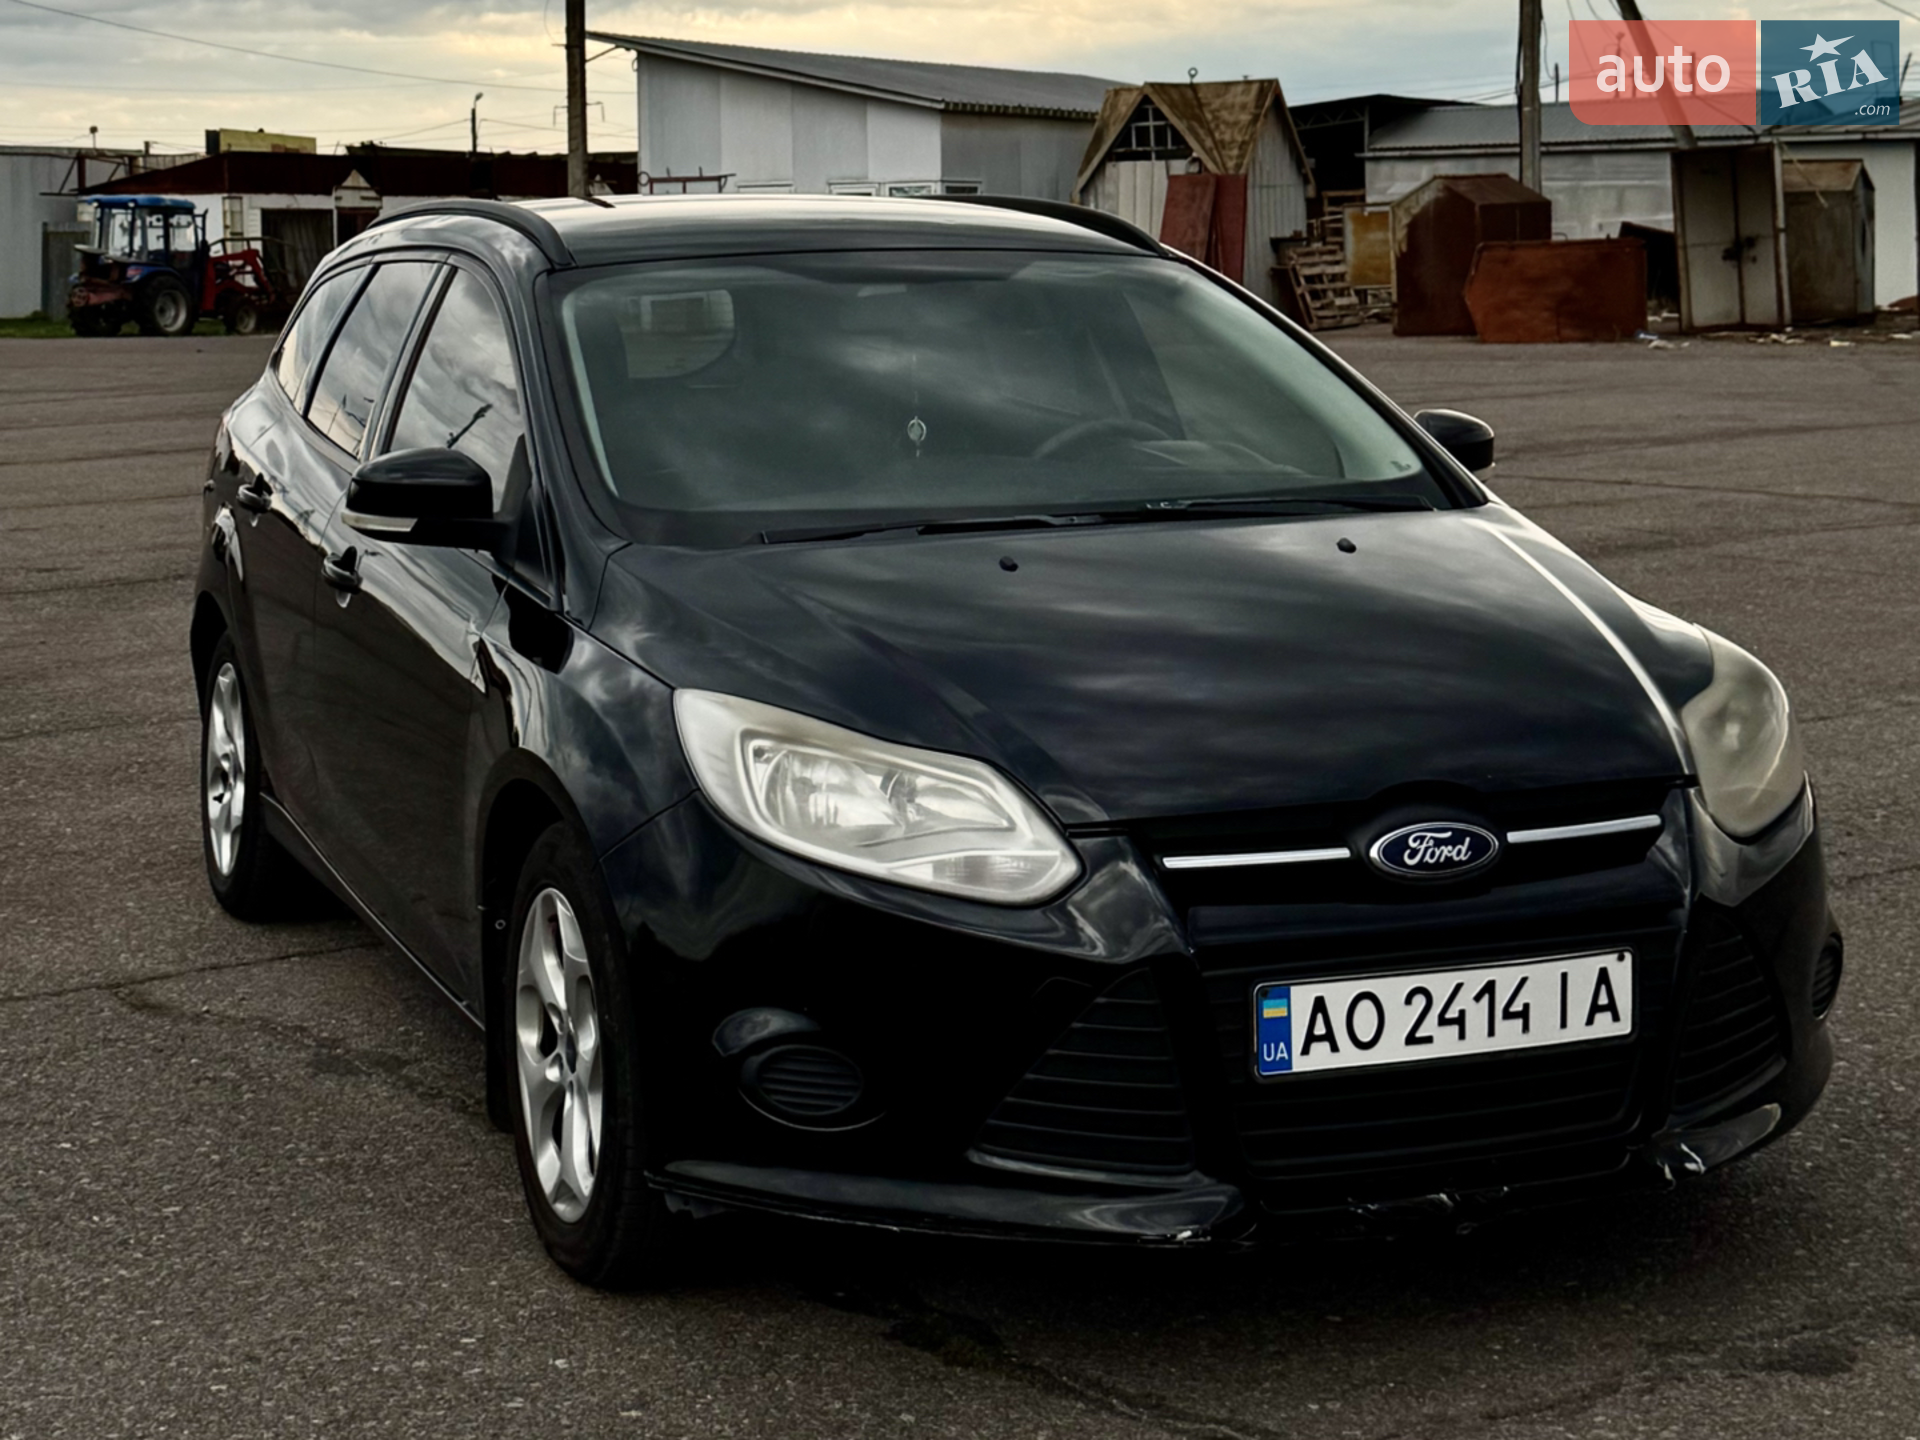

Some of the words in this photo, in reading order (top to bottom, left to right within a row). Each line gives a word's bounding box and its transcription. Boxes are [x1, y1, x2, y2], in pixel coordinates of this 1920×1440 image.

[1403, 831, 1472, 866] Ford
[1300, 990, 1386, 1056] AO
[1402, 976, 1531, 1046] 2414
[1558, 966, 1621, 1029] IA
[1262, 1042, 1289, 1062] UA
